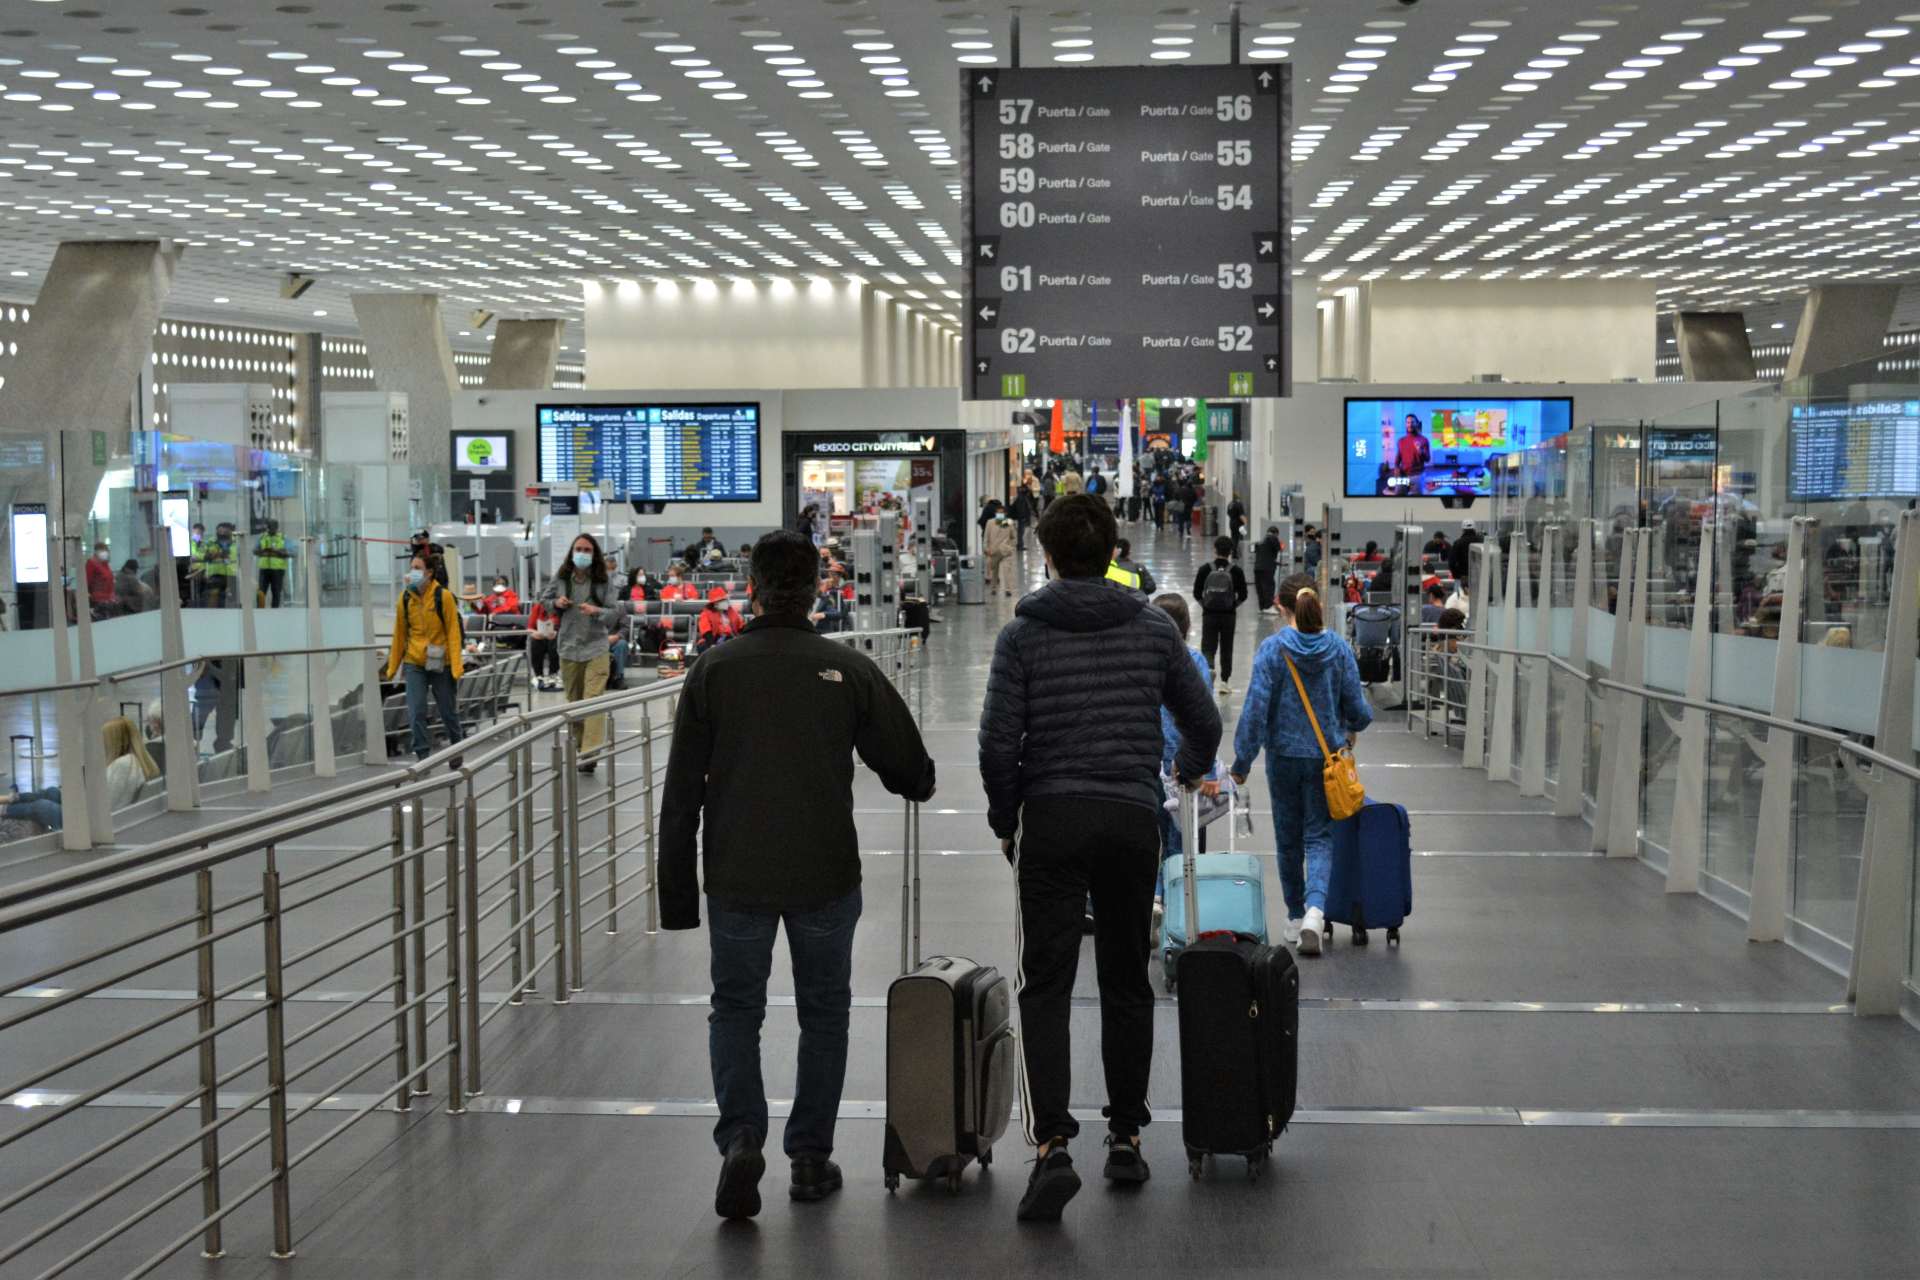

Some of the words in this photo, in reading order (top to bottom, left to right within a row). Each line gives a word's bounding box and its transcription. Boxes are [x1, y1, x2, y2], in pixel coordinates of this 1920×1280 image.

[1000, 100, 1033, 124] 57
[1038, 107, 1076, 117] Puerta
[1086, 107, 1110, 117] Gate
[1141, 106, 1179, 116] Puerta
[1190, 106, 1213, 115] Gate
[1218, 96, 1251, 120] 56
[1001, 134, 1034, 158] 58
[1039, 142, 1076, 152] Puerta
[1087, 143, 1110, 152] Gate
[1141, 151, 1179, 162] Puerta
[1190, 152, 1213, 161] Gate
[1218, 141, 1251, 165] 55
[1001, 168, 1034, 192] 59
[1039, 178, 1076, 188] Puerta
[1087, 178, 1110, 187] Gate
[1142, 196, 1179, 206] Puerta
[1190, 196, 1214, 206] Gate
[1218, 186, 1252, 210] 54
[1001, 203, 1034, 227] 60
[1039, 213, 1077, 223] Puerta
[1087, 213, 1110, 223] Gate
[1001, 266, 1031, 291] 61
[1039, 275, 1077, 285] Puerta
[1088, 276, 1111, 285] Gate
[1142, 274, 1180, 285] Puerta
[1191, 275, 1214, 284] Gate
[1219, 264, 1251, 288] 53
[1002, 329, 1034, 353] 62
[1040, 336, 1077, 346] Puerta
[1088, 336, 1111, 345] Gate
[1143, 337, 1180, 347] Puerta
[1191, 337, 1214, 346] Gate
[1219, 326, 1252, 351] 52
[553, 409, 586, 422] Salidas
[662, 409, 695, 421] Salidas
[813, 442, 850, 452] MEXICO
